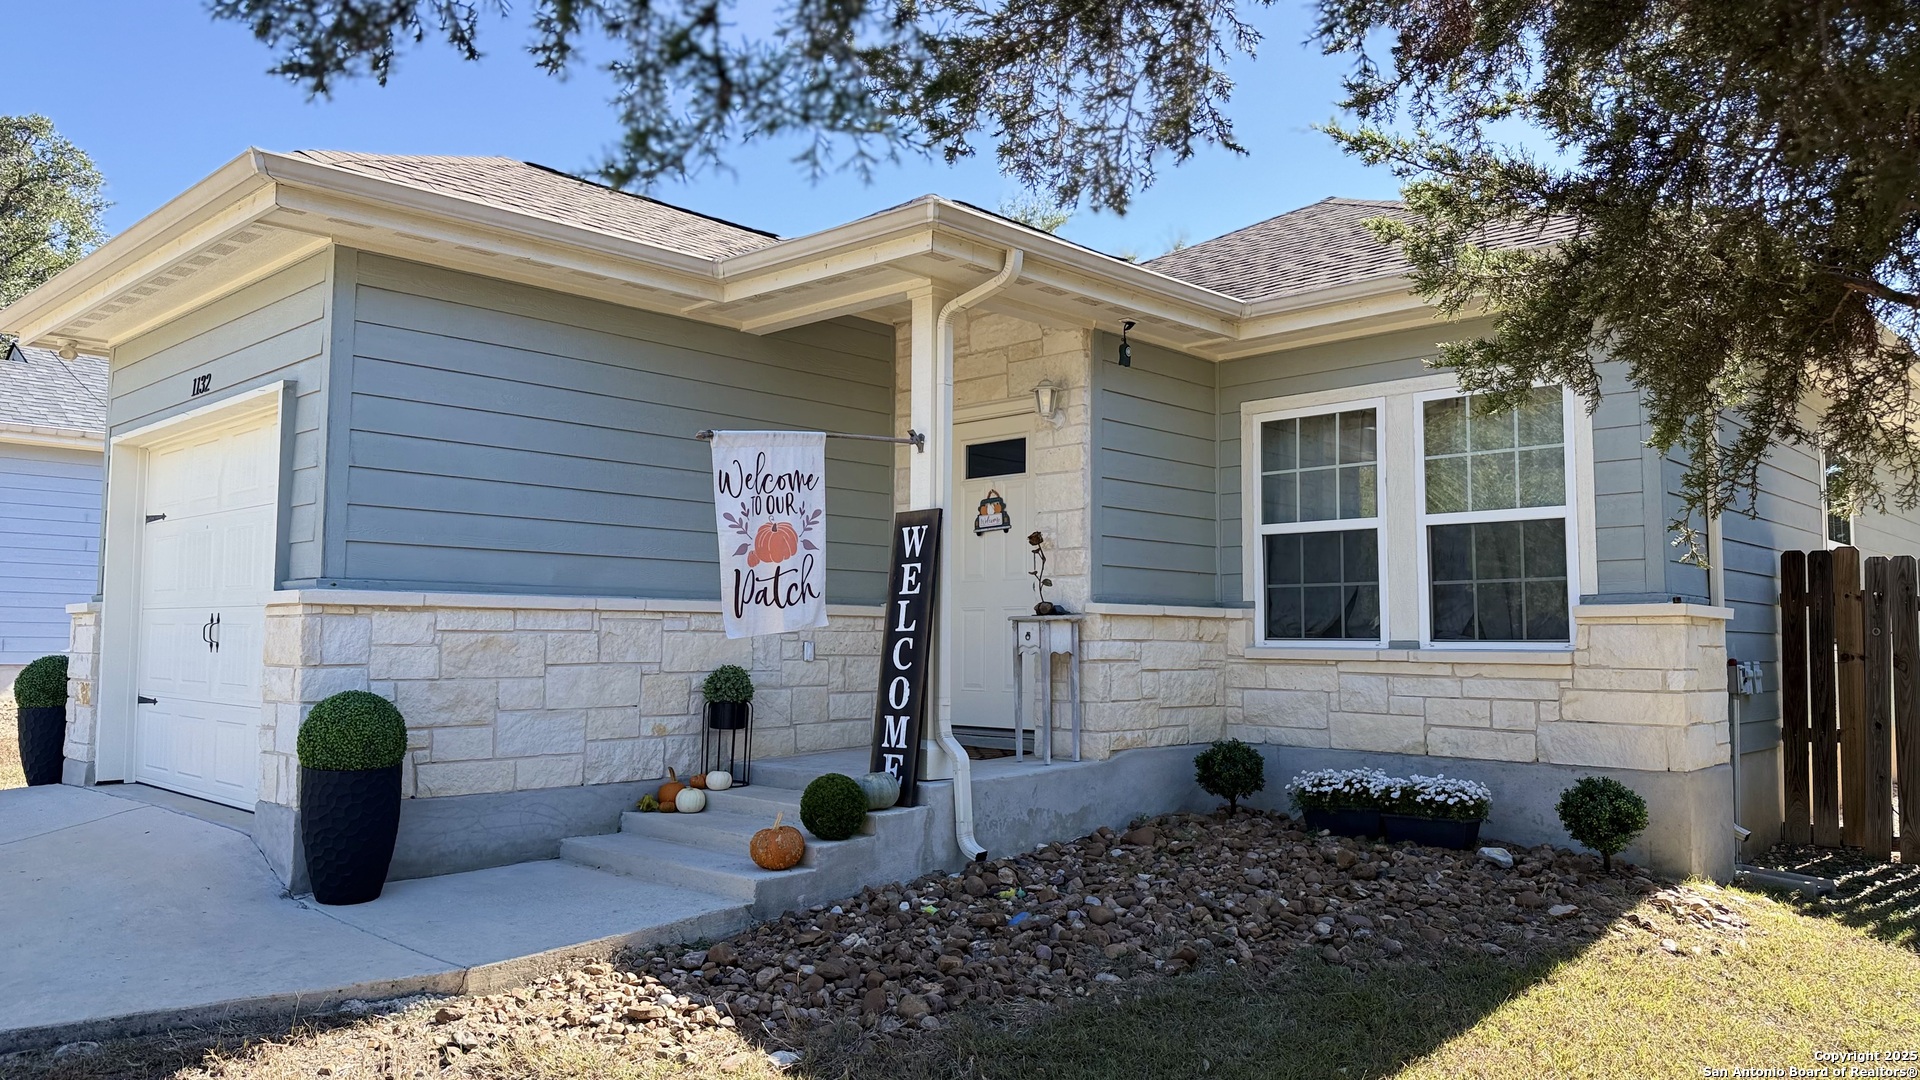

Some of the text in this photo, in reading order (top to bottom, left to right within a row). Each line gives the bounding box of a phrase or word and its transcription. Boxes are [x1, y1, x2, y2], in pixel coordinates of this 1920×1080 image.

[191, 373, 212, 397] 1132
[718, 451, 820, 498] Welcome
[751, 492, 798, 517] TO OUR
[734, 553, 820, 619] Patch
[881, 525, 929, 788] WELCOME
